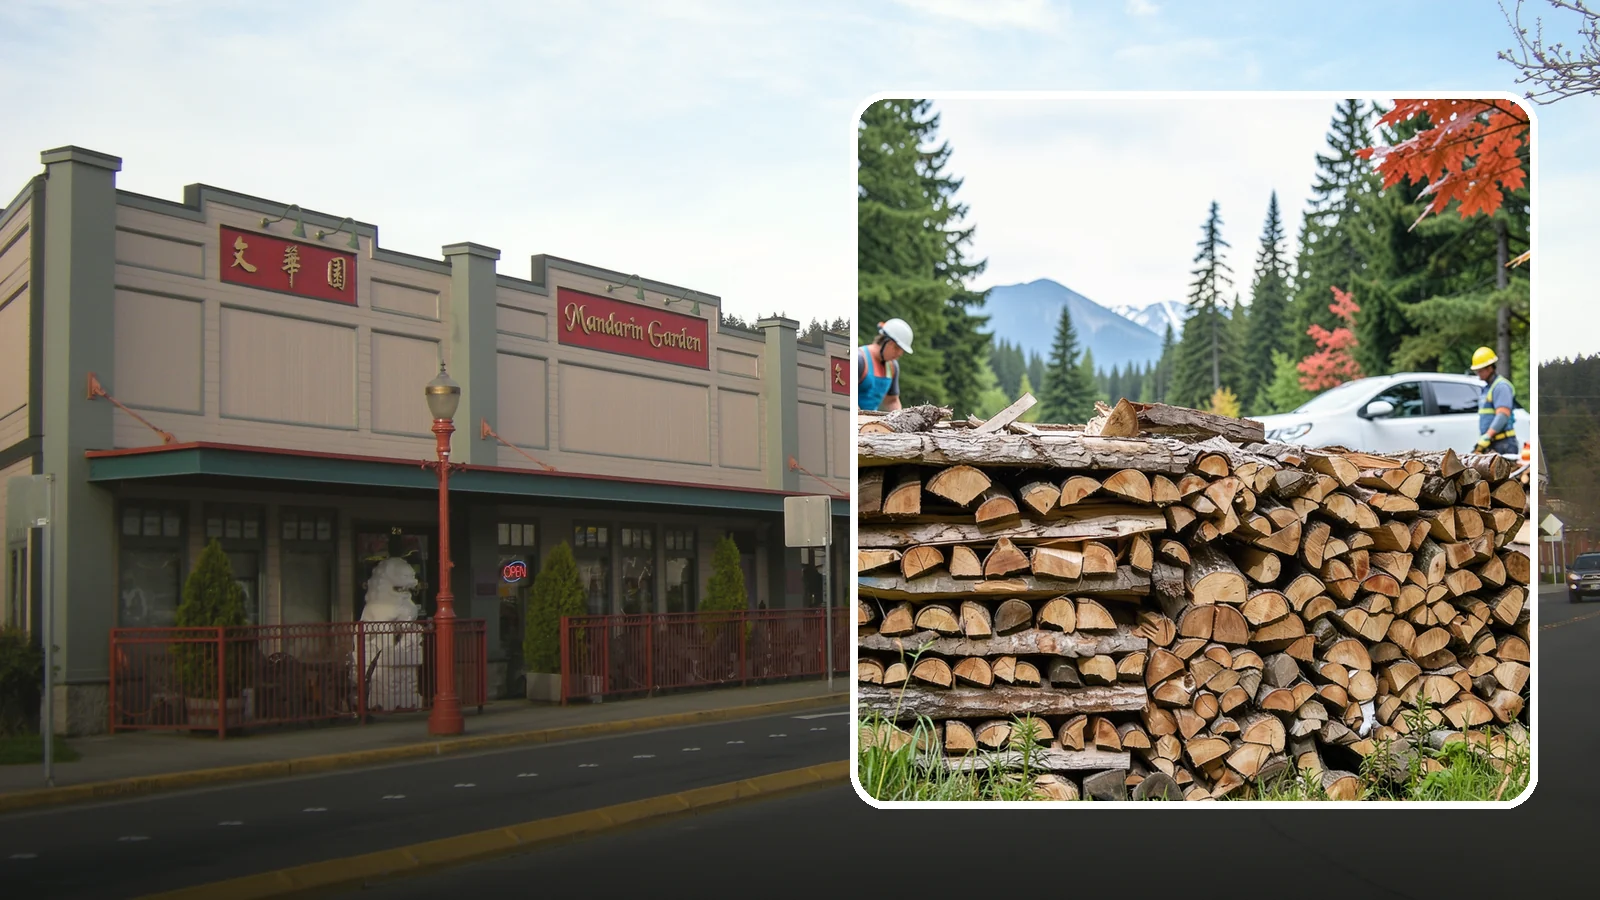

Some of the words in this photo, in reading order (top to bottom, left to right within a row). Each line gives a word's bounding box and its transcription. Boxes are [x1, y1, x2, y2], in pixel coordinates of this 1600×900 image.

[231, 235, 346, 292] 文華園
[564, 302, 644, 341] Mandarin
[648, 320, 701, 352] Garden
[504, 566, 526, 578] OPEN
